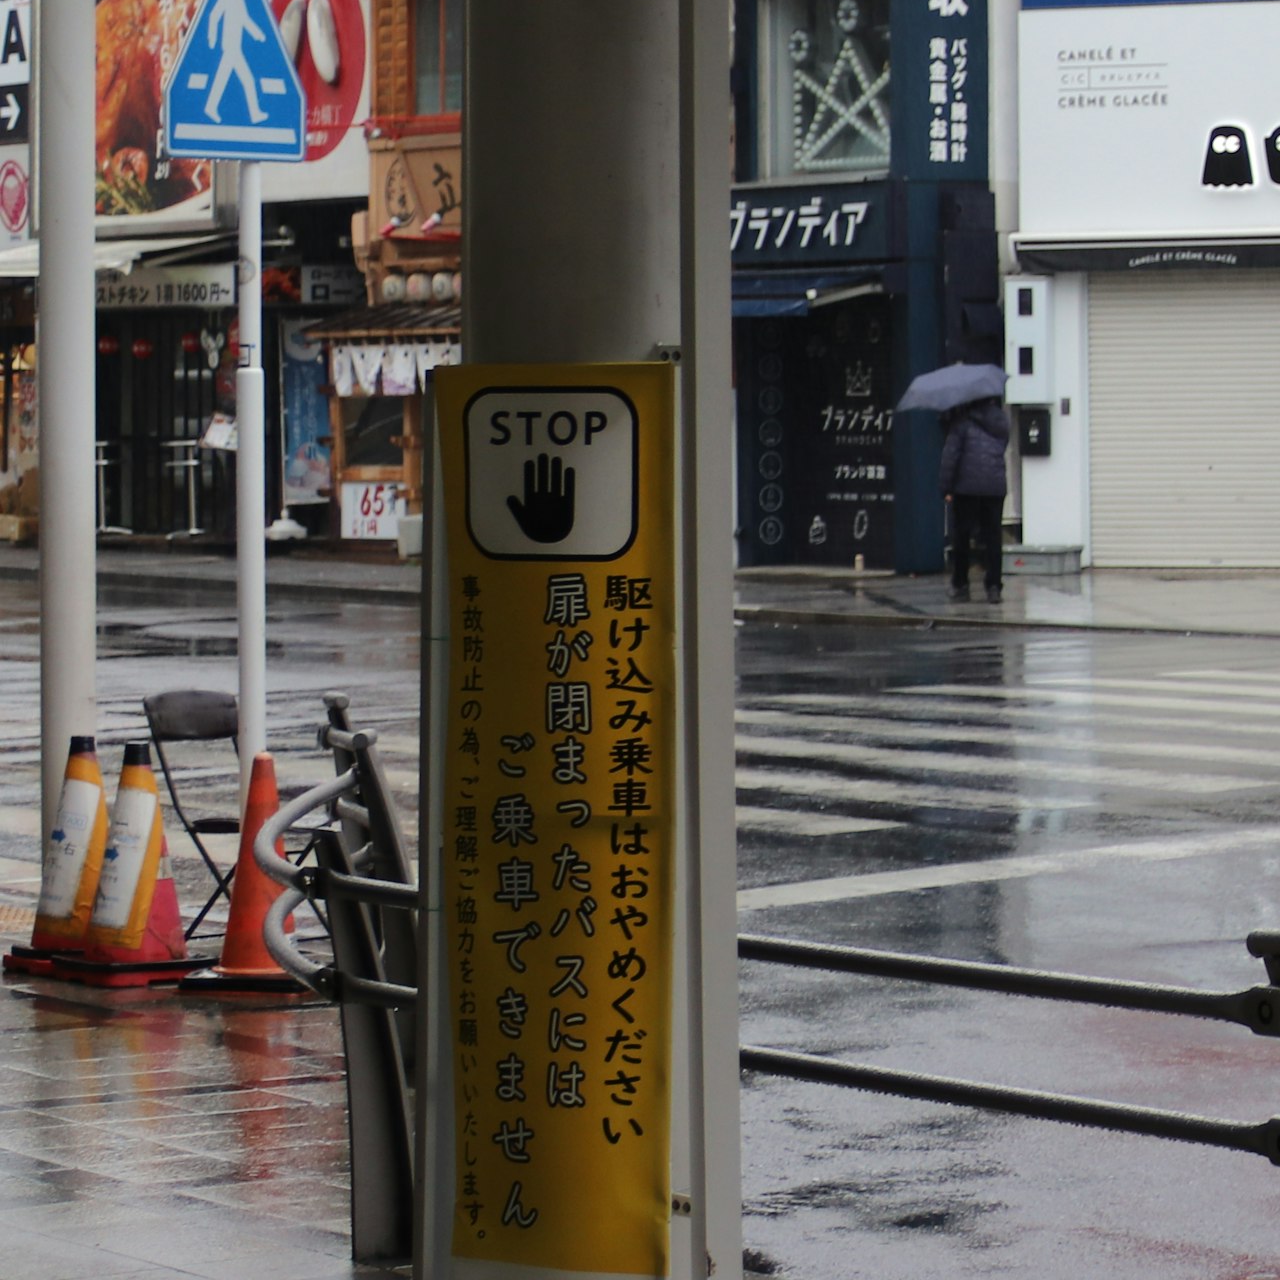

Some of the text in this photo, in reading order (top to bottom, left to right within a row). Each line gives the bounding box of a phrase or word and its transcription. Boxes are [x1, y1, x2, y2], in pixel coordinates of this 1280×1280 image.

[1058, 46, 1136, 61] CANELÉ ET
[489, 411, 608, 446] STOP
[491, 732, 541, 1228] ご乗車できません
[544, 572, 597, 1108] 扉が閉まったバスには
[603, 575, 654, 1145] 駆け込み乗車はおやめください
